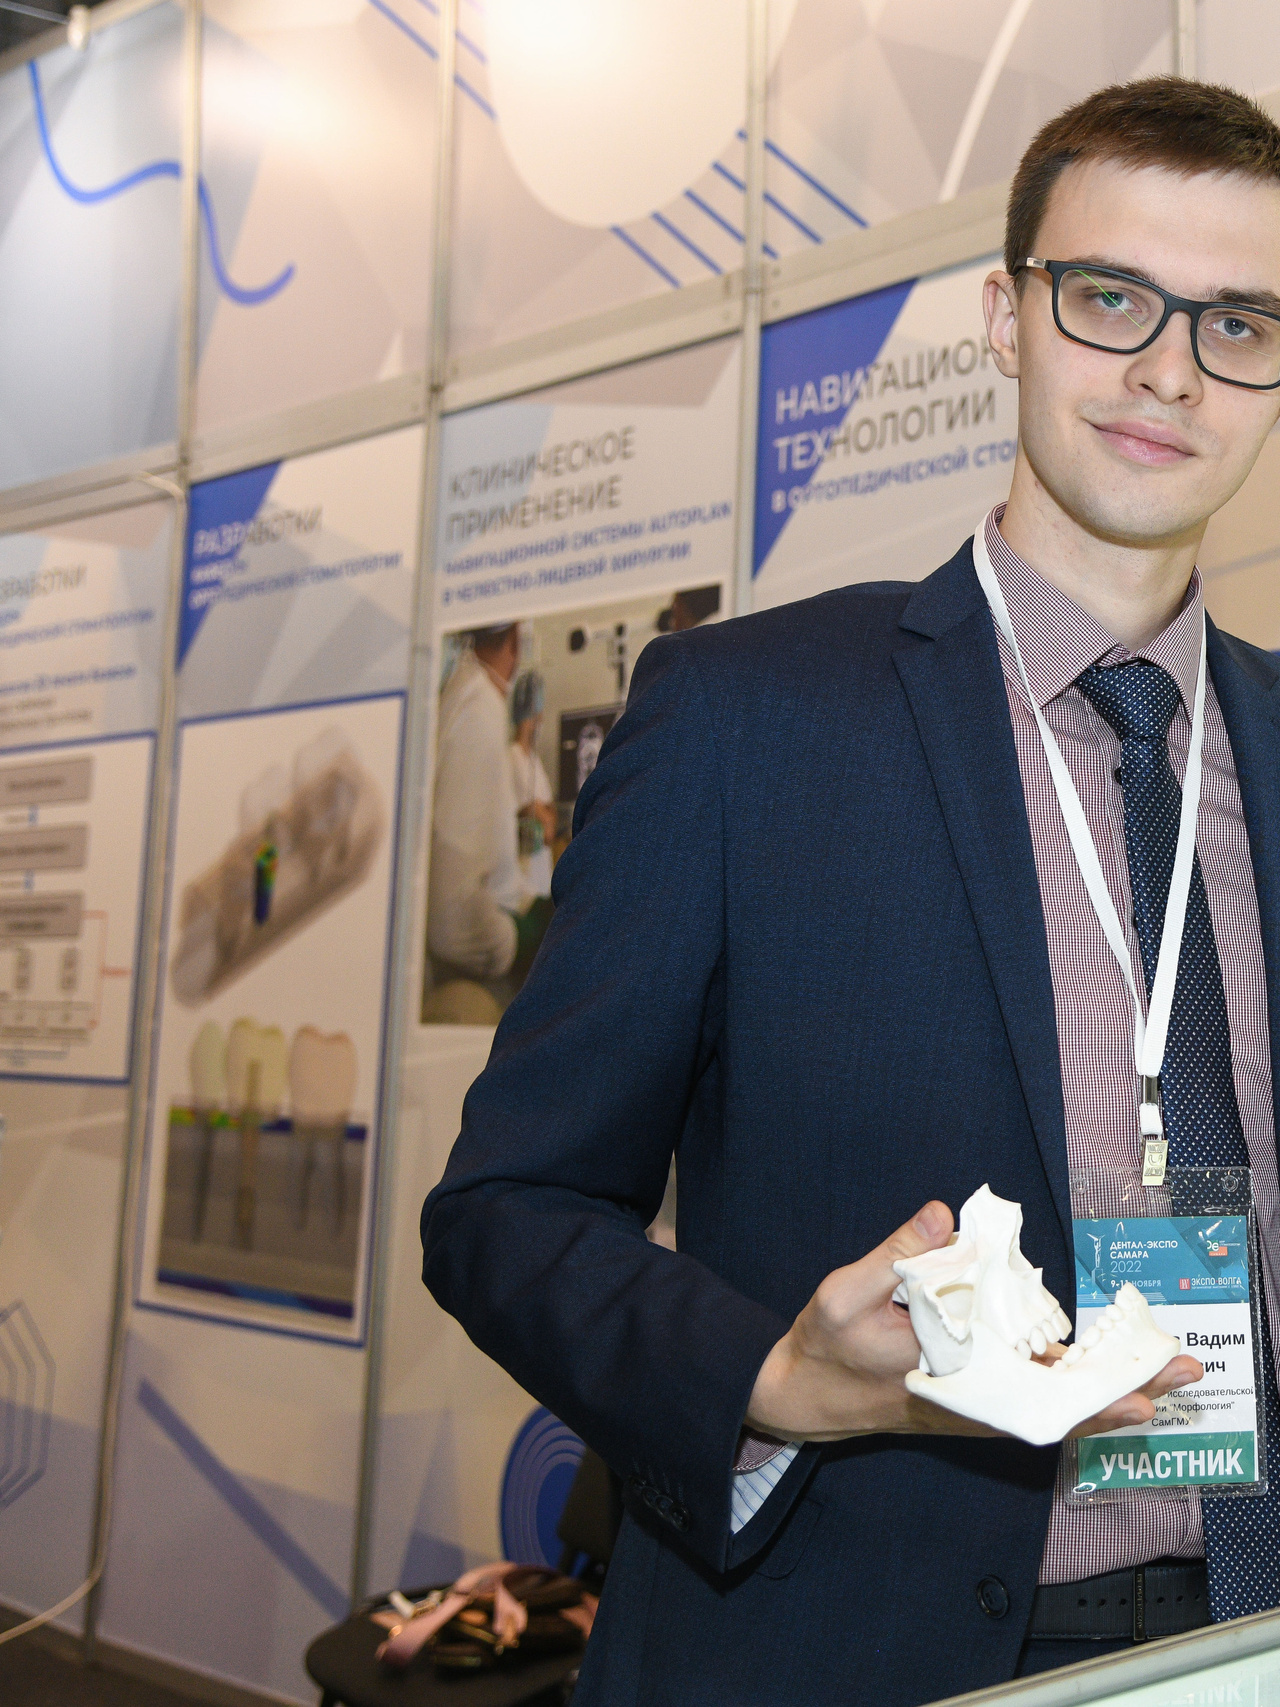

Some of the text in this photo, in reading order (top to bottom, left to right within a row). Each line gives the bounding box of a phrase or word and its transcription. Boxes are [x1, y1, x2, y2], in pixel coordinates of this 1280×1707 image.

[773, 387, 996, 474] ТЕХНОЛОГИИ
[450, 425, 637, 500] КЛИНИЧЕСКОЕ
[972, 438, 1017, 469] СТО
[446, 474, 623, 541] ПРИМЕНЕНИЕ
[1110, 1240, 1178, 1251] ДЕНТАЛ-ЭКСПО
[1110, 1250, 1149, 1259] САМАРА
[1110, 1260, 1142, 1273] 2022
[1186, 1332, 1245, 1350] Вадим
[1201, 1360, 1226, 1373] ич
[1100, 1448, 1244, 1481] УЧАСТНИК
